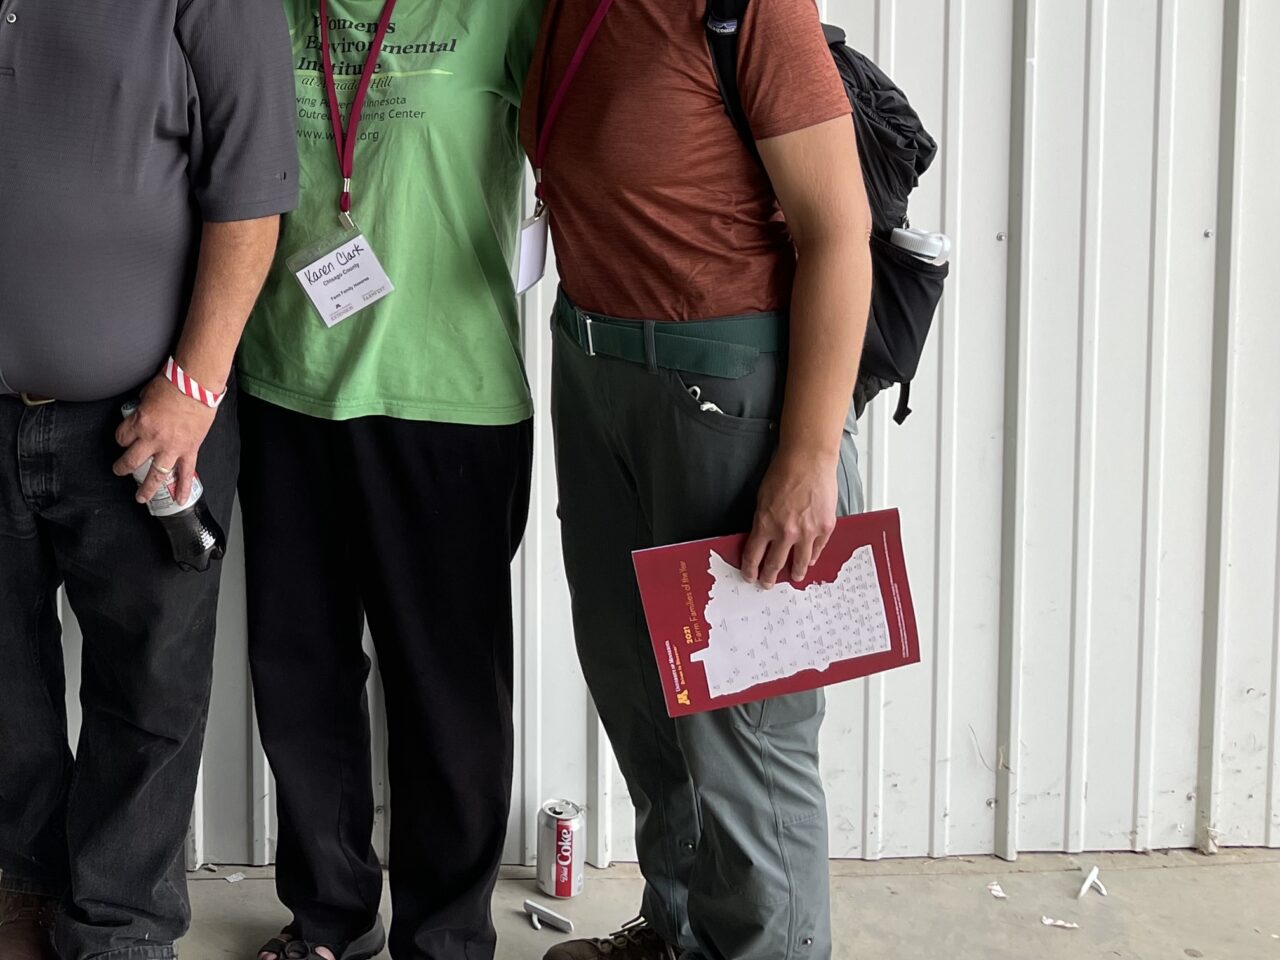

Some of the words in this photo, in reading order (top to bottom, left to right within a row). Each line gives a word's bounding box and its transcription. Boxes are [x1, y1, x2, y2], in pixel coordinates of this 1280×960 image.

[370, 76, 393, 90] Hill
[363, 96, 407, 109] innesota
[388, 109, 426, 120] Center
[304, 262, 335, 286] Karen
[336, 244, 364, 266] Clark
[342, 263, 360, 275] County
[686, 592, 698, 622] Families
[683, 626, 694, 644] 2021
[694, 623, 702, 642] Farm
[557, 828, 572, 866] Coke
